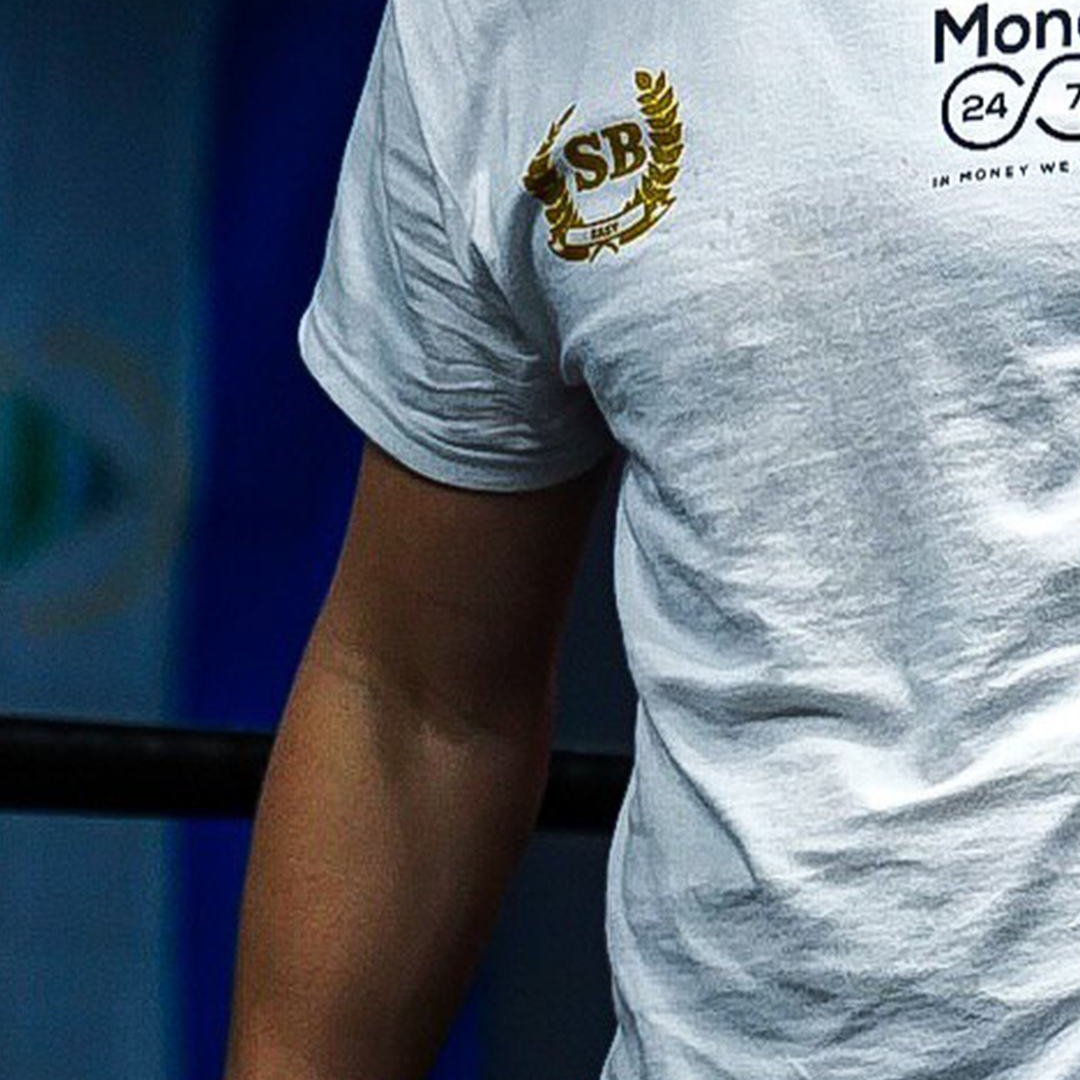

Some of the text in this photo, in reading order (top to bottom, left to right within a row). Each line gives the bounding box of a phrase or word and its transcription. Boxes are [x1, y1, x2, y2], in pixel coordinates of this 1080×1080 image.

[962, 93, 1008, 122] 24
[563, 122, 647, 192] SB
[932, 176, 950, 189] IN
[959, 164, 1029, 183] MONEY
[1040, 160, 1070, 175] WE
